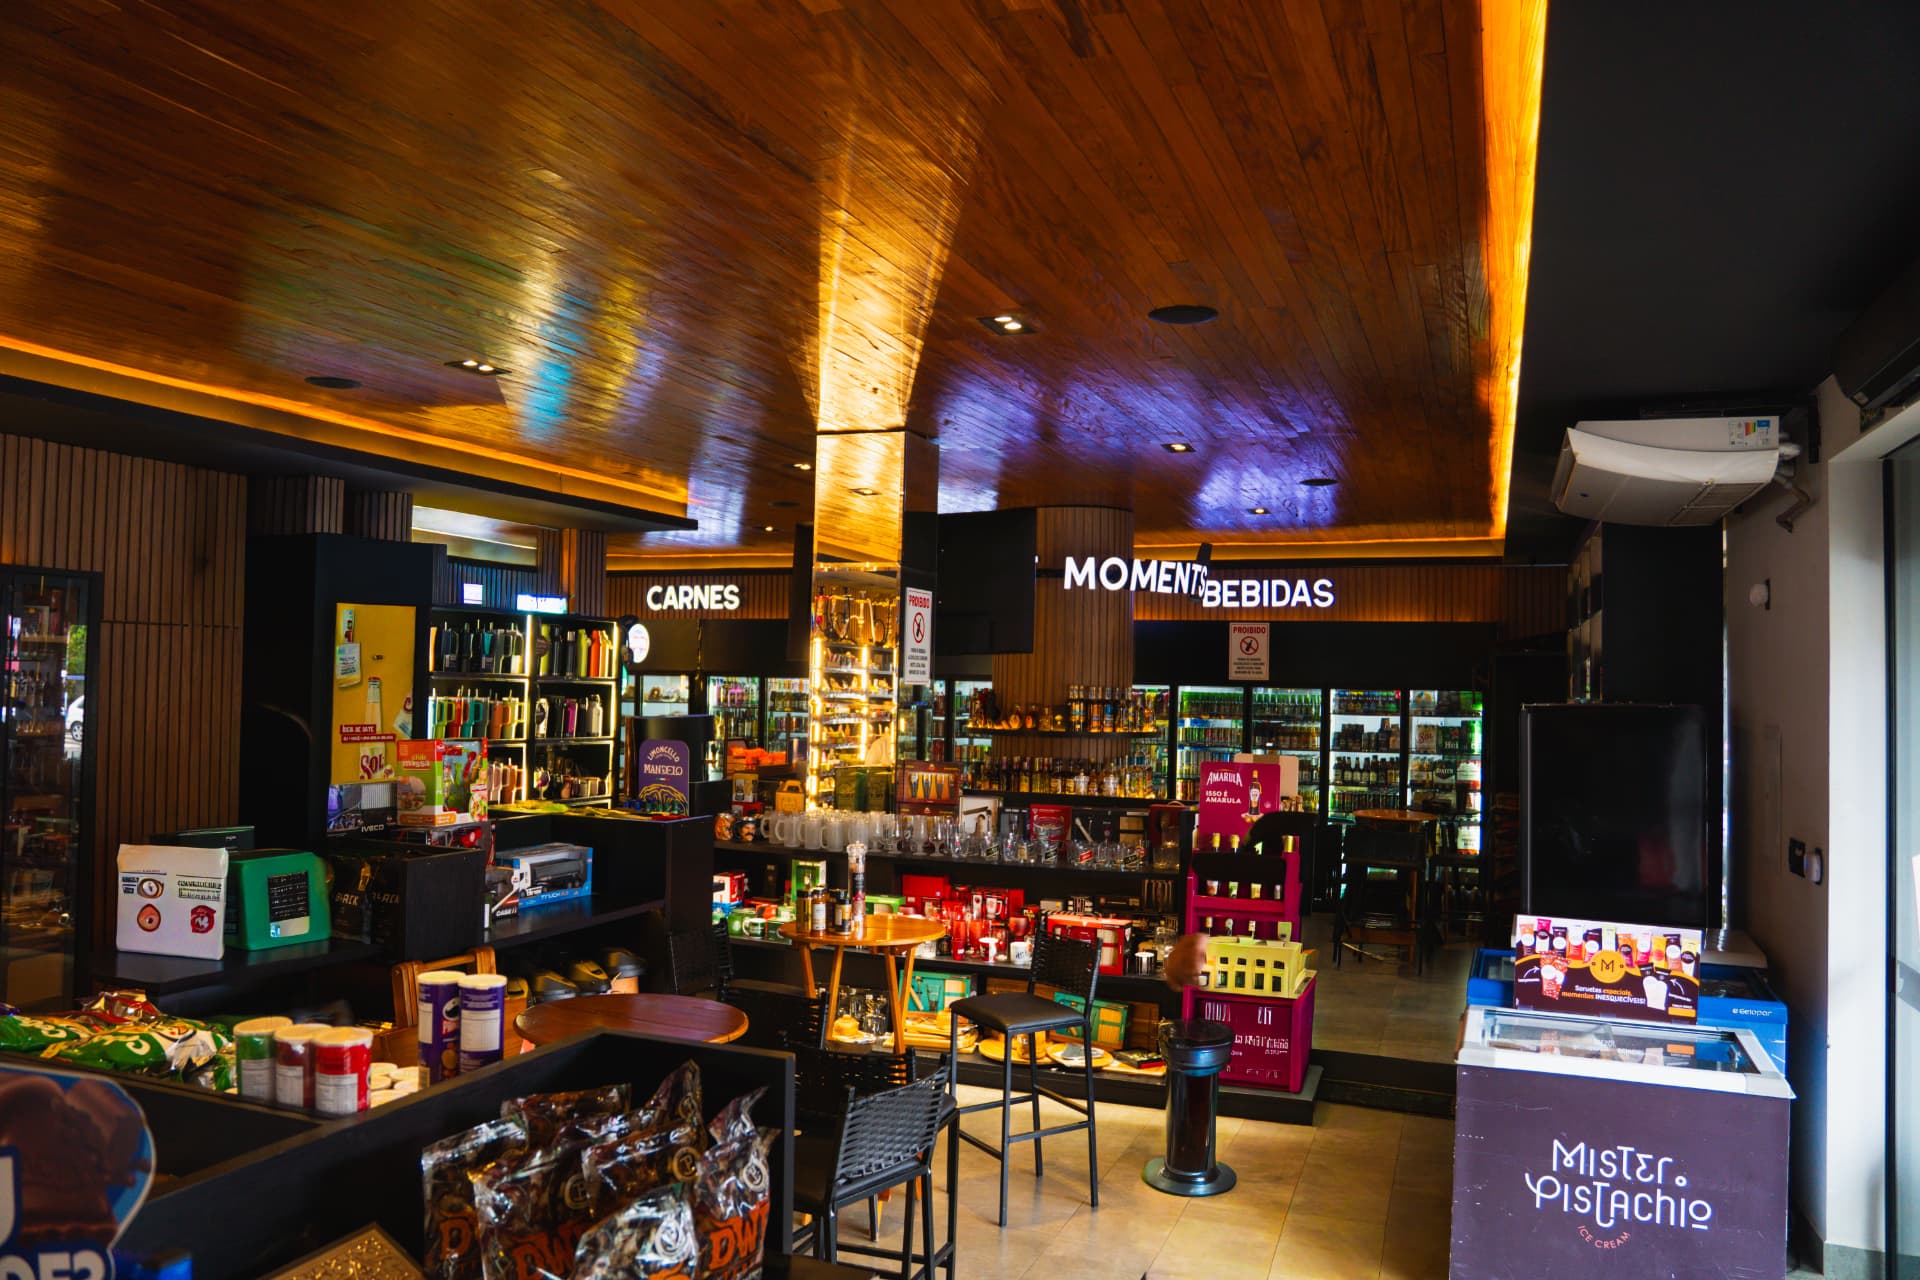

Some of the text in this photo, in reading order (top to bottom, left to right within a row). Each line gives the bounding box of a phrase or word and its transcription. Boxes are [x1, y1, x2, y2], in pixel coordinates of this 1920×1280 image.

[1063, 556, 1207, 599] MOMENTS
[646, 584, 740, 611] CARNES
[908, 594, 930, 609] PROIBIDO
[1202, 579, 1335, 608] BEBIDAS
[1233, 626, 1266, 634] PROIBIDO
[1206, 771, 1243, 787] AMARULA
[1205, 796, 1242, 804] AMARULA
[1575, 1224, 1632, 1250] ICE CREAM
